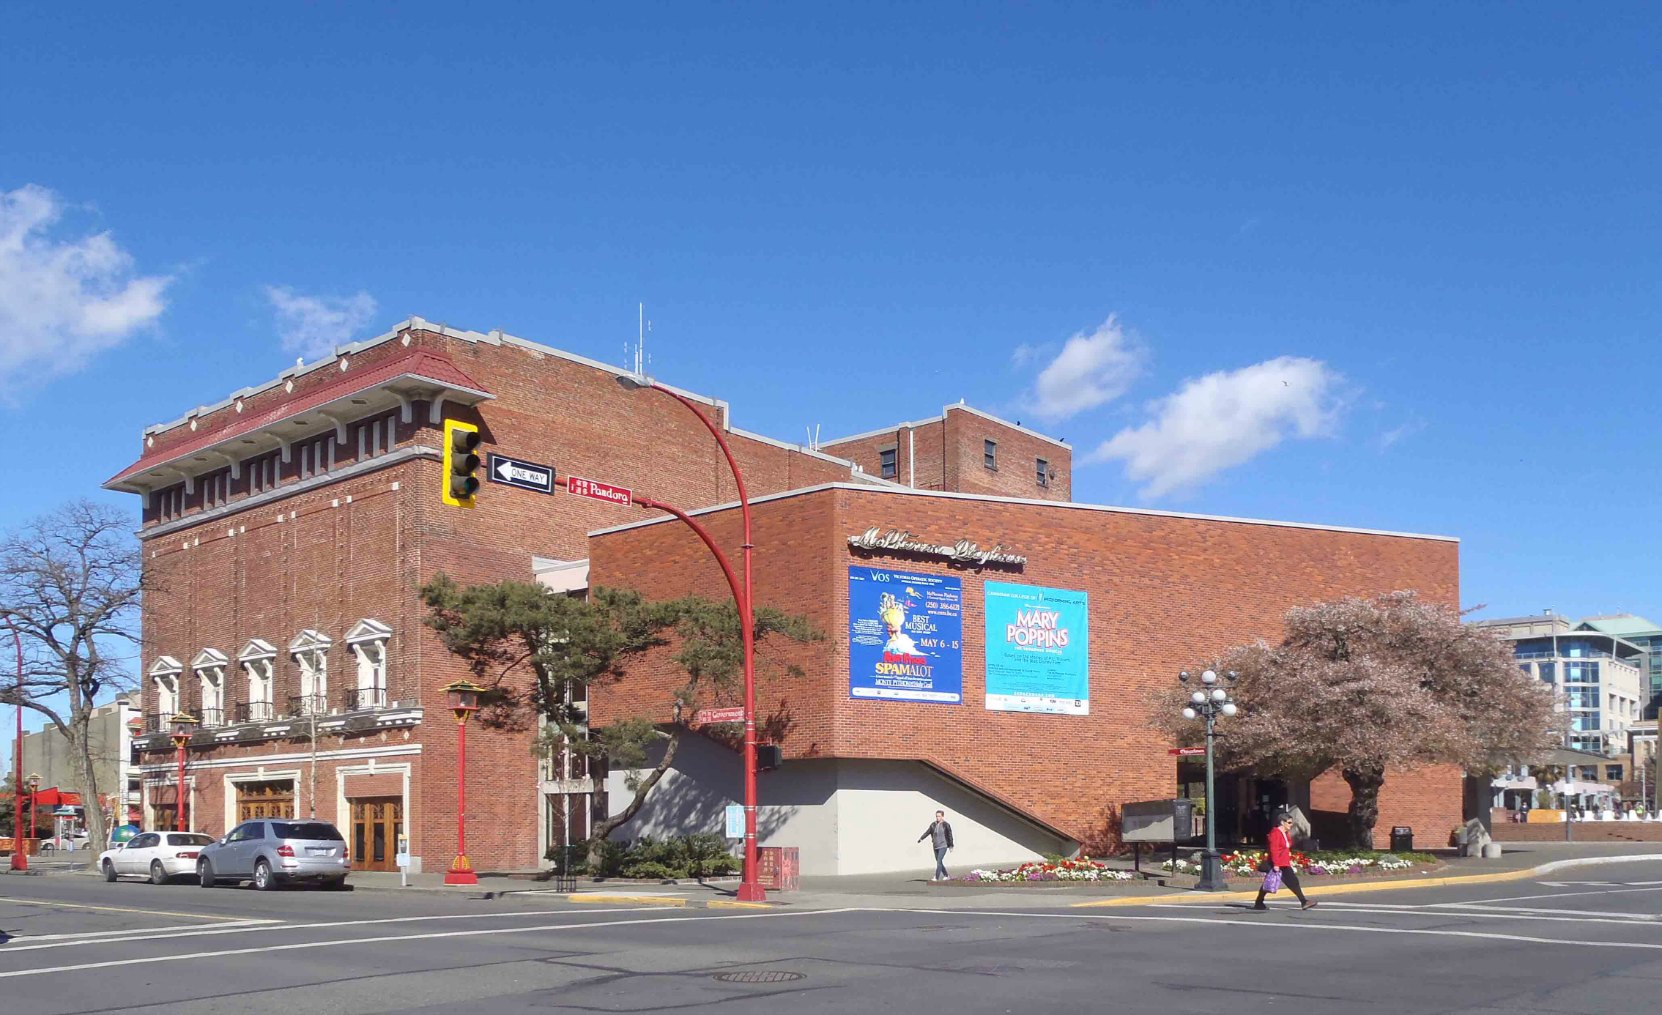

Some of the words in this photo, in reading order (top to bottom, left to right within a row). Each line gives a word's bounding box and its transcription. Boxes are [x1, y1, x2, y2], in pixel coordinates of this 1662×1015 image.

[511, 468, 527, 480] ONE
[529, 471, 545, 483] WAY
[590, 483, 629, 502] Pandora
[949, 537, 1028, 565] Playhouse
[925, 601, 939, 609] (250)
[905, 621, 938, 632] MUSICAL
[912, 614, 930, 624] BEST
[1016, 609, 1059, 630] MARY
[1007, 625, 1068, 647] POPPINS
[920, 638, 938, 648] MAY
[939, 640, 946, 648] 6
[951, 640, 959, 650] 15
[875, 662, 933, 678] SPAMALOT
[712, 709, 744, 718] Government
